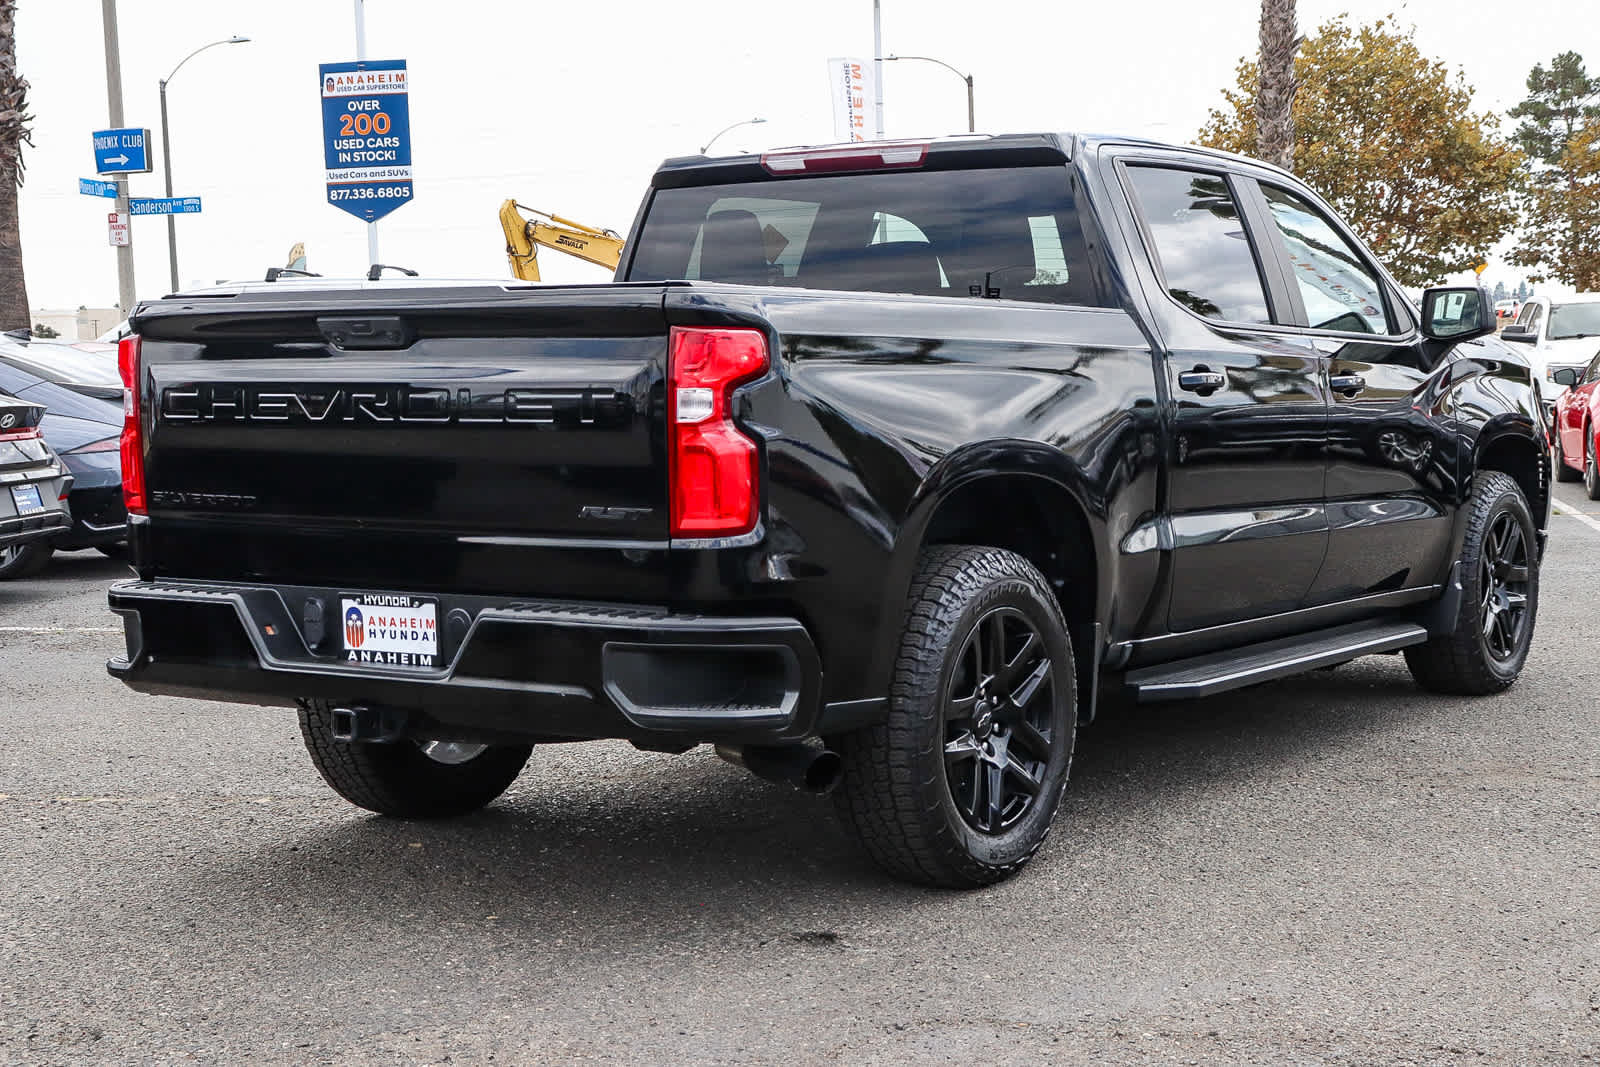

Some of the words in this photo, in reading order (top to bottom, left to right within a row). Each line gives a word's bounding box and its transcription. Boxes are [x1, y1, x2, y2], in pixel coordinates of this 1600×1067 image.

[337, 73, 405, 86] ANAHEIM
[366, 83, 405, 91] SUPERSTORE
[347, 100, 381, 112] OVER
[339, 112, 391, 136] 200
[94, 135, 119, 150] PHOENIX
[122, 134, 143, 148] CLUB
[334, 138, 364, 150] USED
[366, 137, 400, 148] CARS
[339, 152, 351, 163] IN
[352, 150, 396, 162] STOCK!
[328, 171, 349, 180] Used
[349, 170, 368, 178] Cars
[369, 168, 386, 177] and
[387, 168, 409, 177] SUVs
[329, 186, 410, 201] 877.336.6805
[131, 200, 173, 214] Sanderson
[161, 386, 619, 424] CHEVROLET
[363, 594, 410, 607] HYUNDAI
[368, 615, 435, 629] ANAHEIM
[369, 629, 436, 642] HYUNDAI
[347, 650, 432, 666] ANAHEIM
